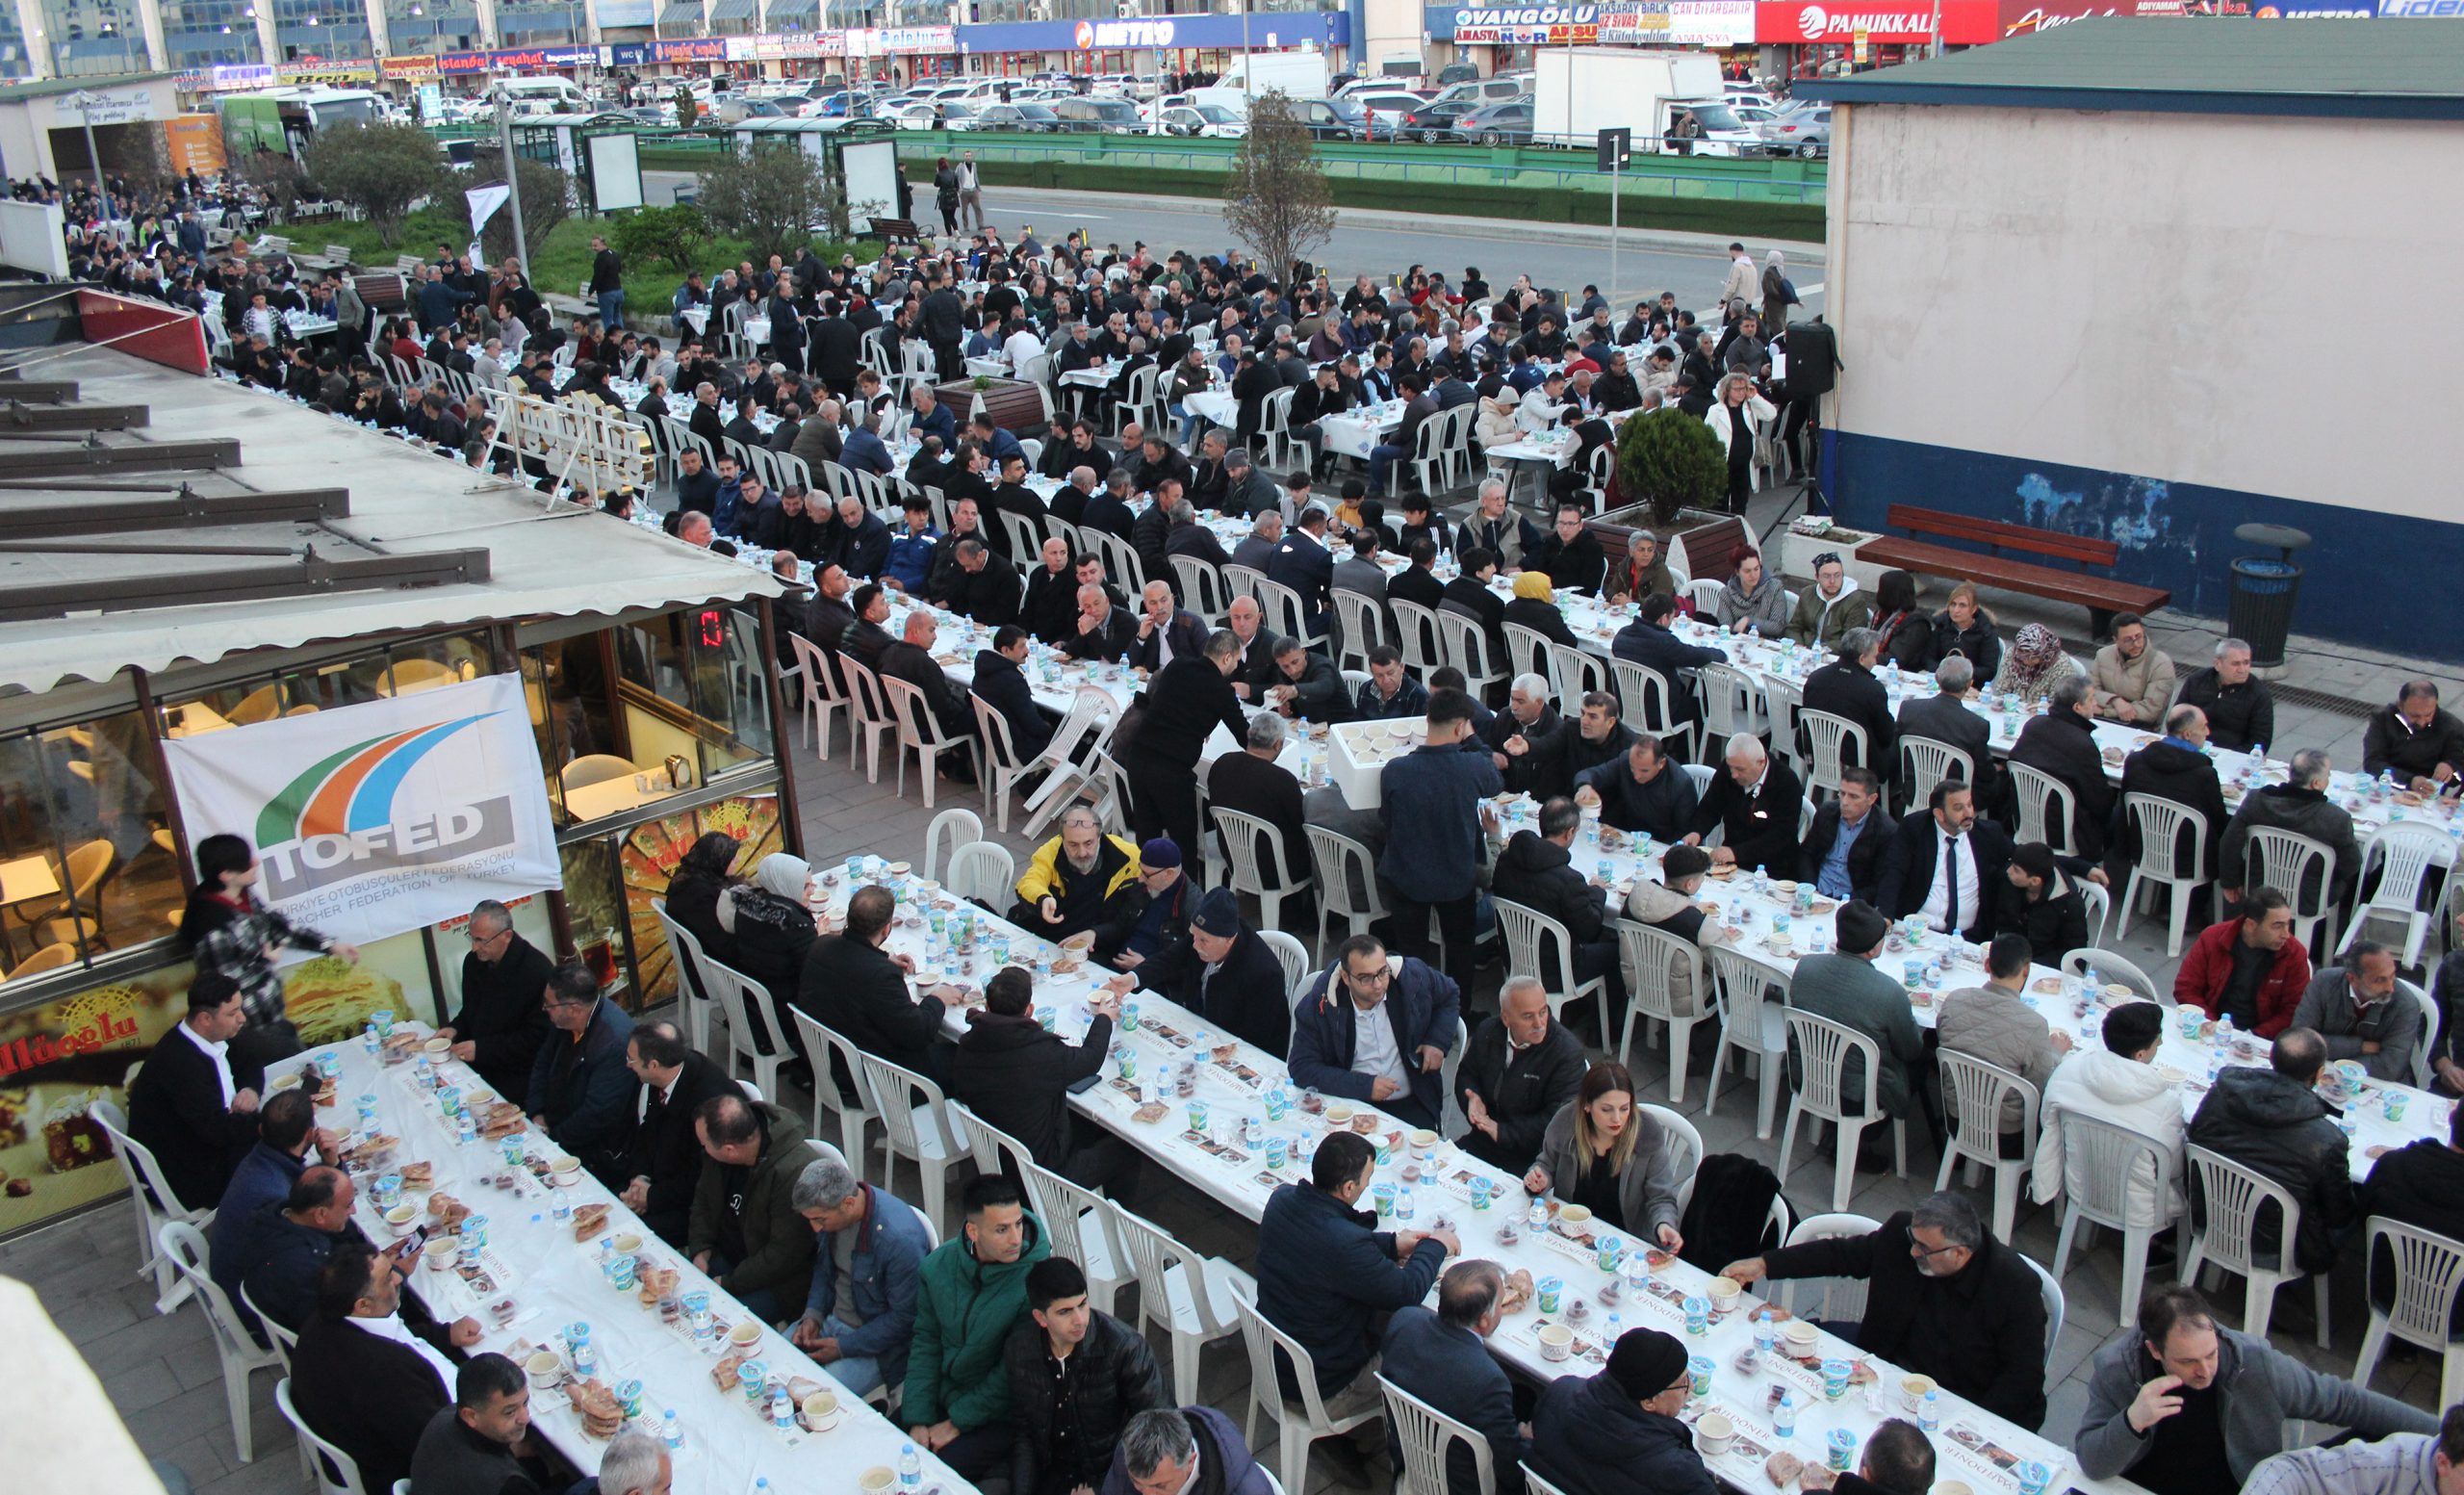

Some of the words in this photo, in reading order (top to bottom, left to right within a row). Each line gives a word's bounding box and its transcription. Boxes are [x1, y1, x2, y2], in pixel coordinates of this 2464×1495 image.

[1095, 21, 1174, 47] METRO
[260, 805, 484, 883] TOFED
[424, 849, 515, 878] FEDERASYONU
[347, 878, 432, 911] FEDERATION
[465, 863, 517, 880] TURKEY
